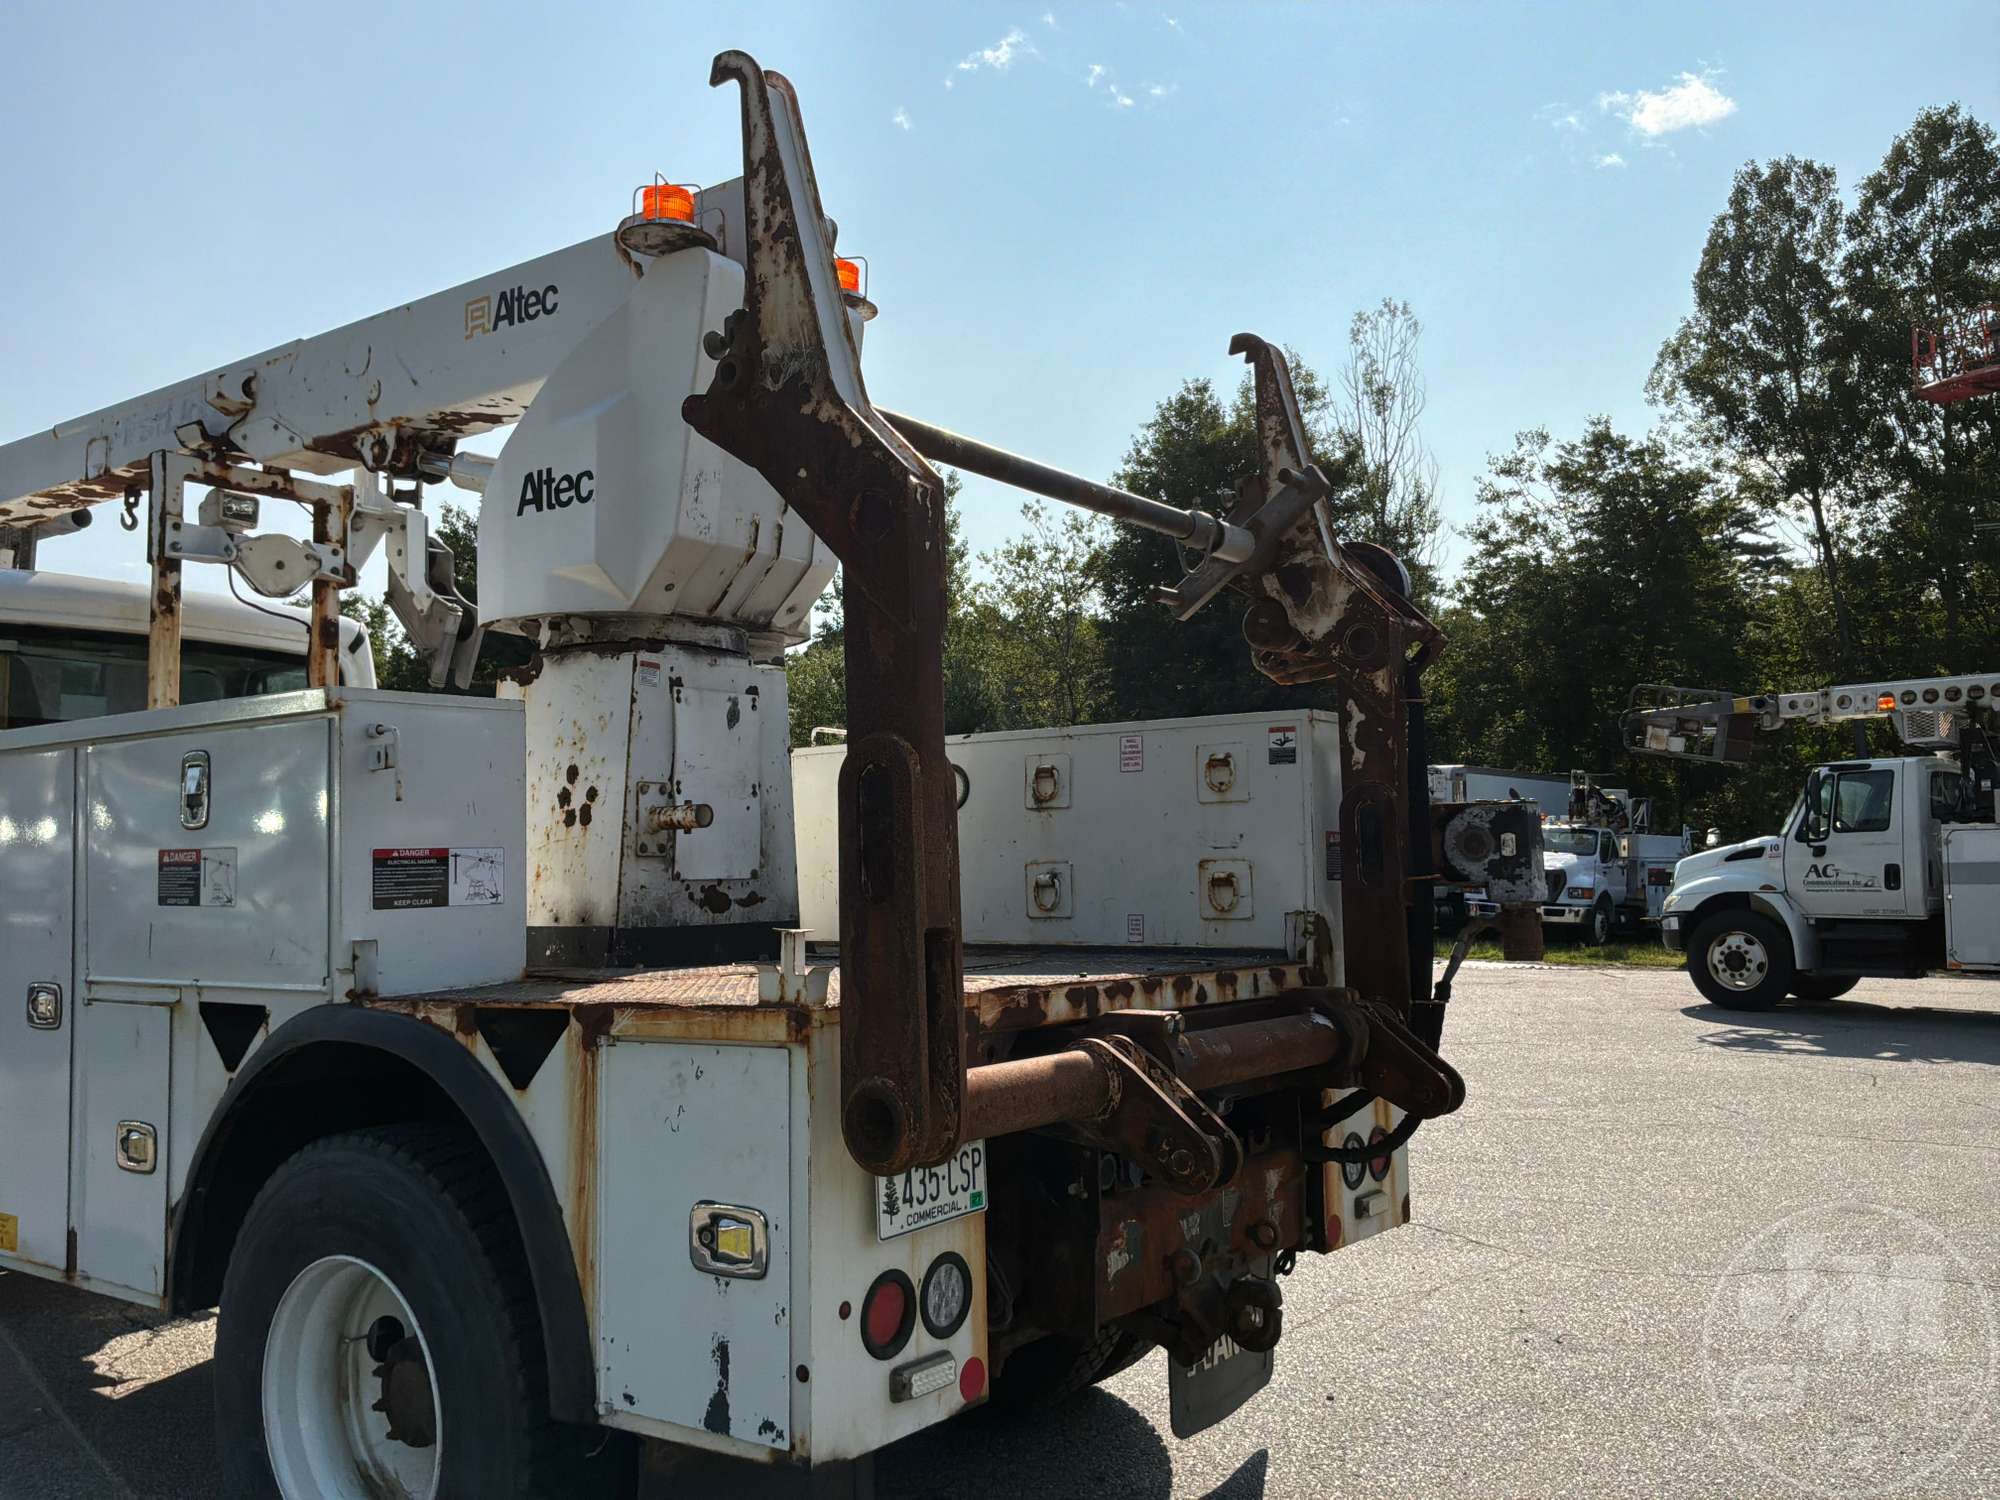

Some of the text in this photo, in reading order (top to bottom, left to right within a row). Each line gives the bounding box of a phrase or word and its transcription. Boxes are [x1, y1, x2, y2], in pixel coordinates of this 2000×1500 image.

[492, 285, 559, 332] Altec
[516, 467, 595, 516] Altec
[169, 851, 197, 862] DANGER
[399, 849, 430, 857] DANGER
[906, 1200, 962, 1227] COMMERCIAL
